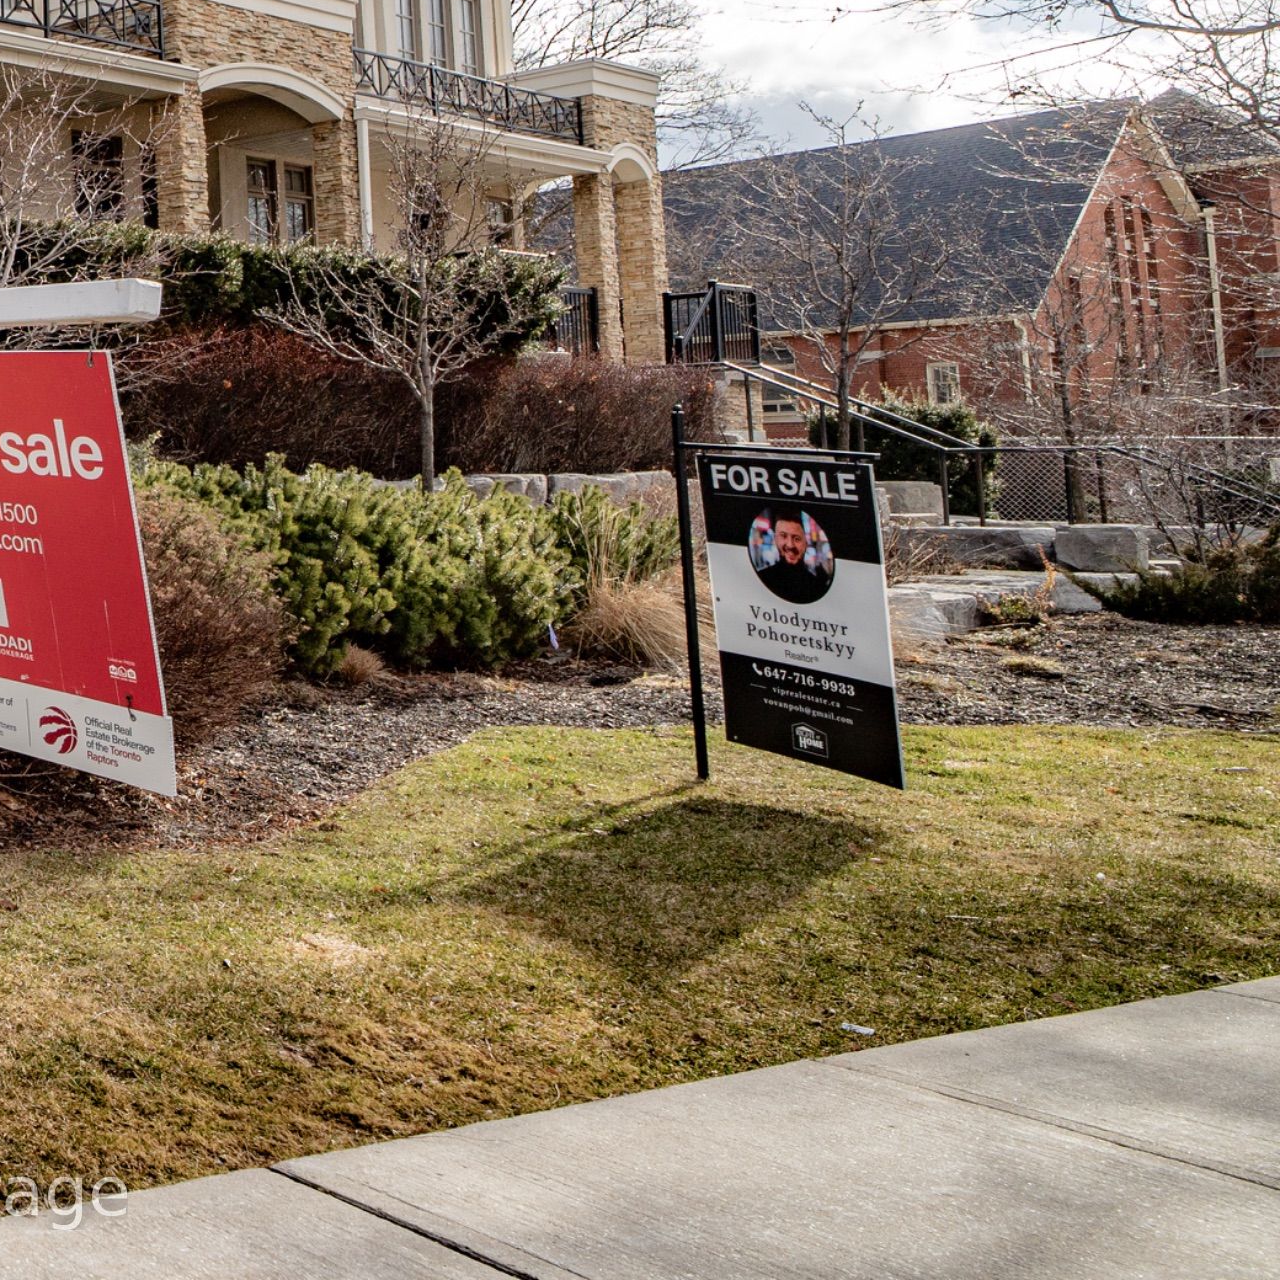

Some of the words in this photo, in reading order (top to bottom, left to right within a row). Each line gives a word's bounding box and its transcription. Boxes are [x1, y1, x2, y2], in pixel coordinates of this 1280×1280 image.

[710, 463, 772, 494] FOR
[777, 468, 860, 502] SALE
[749, 604, 849, 638] Volodymyr
[745, 622, 856, 660] Pohoretskyy
[763, 666, 856, 697] 647-716-9933
[5, 697, 14, 707] of
[772, 686, 841, 709] viprealestate.ca
[763, 697, 854, 726] vovanpoh@gmail.com
[84, 716, 113, 732] Official
[113, 723, 133, 737] Real
[85, 727, 111, 741] Estate
[111, 734, 156, 755] Brokerage
[86, 740, 95, 749] of
[95, 742, 110, 754] the
[109, 745, 142, 762] Toronto
[799, 735, 825, 750] HOME
[86, 750, 119, 768] Raptors
